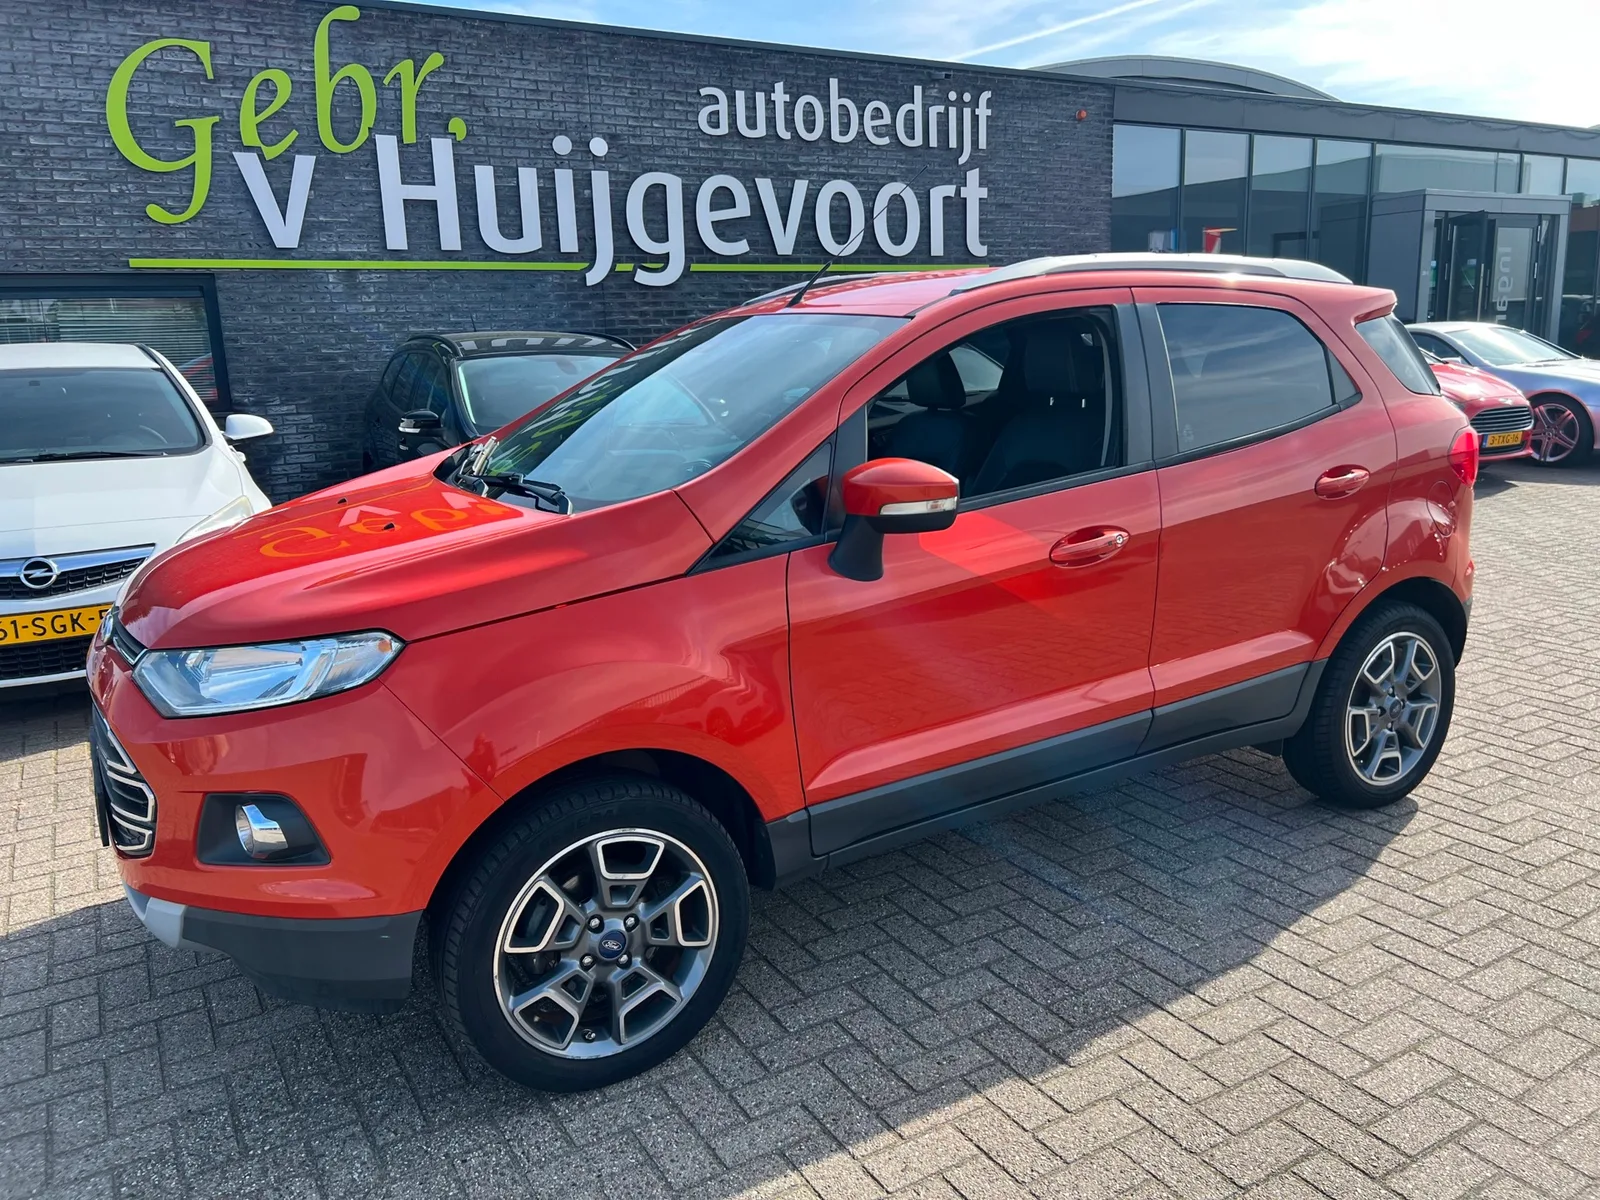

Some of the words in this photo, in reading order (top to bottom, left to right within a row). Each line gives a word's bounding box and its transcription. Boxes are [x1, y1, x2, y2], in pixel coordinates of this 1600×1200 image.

[105, 6, 467, 225] Gebr.
[698, 78, 992, 165] autobedrijf
[232, 151, 316, 249] v
[375, 134, 988, 287] Huijgevoort
[1489, 434, 1519, 446] 3-TXG-16
